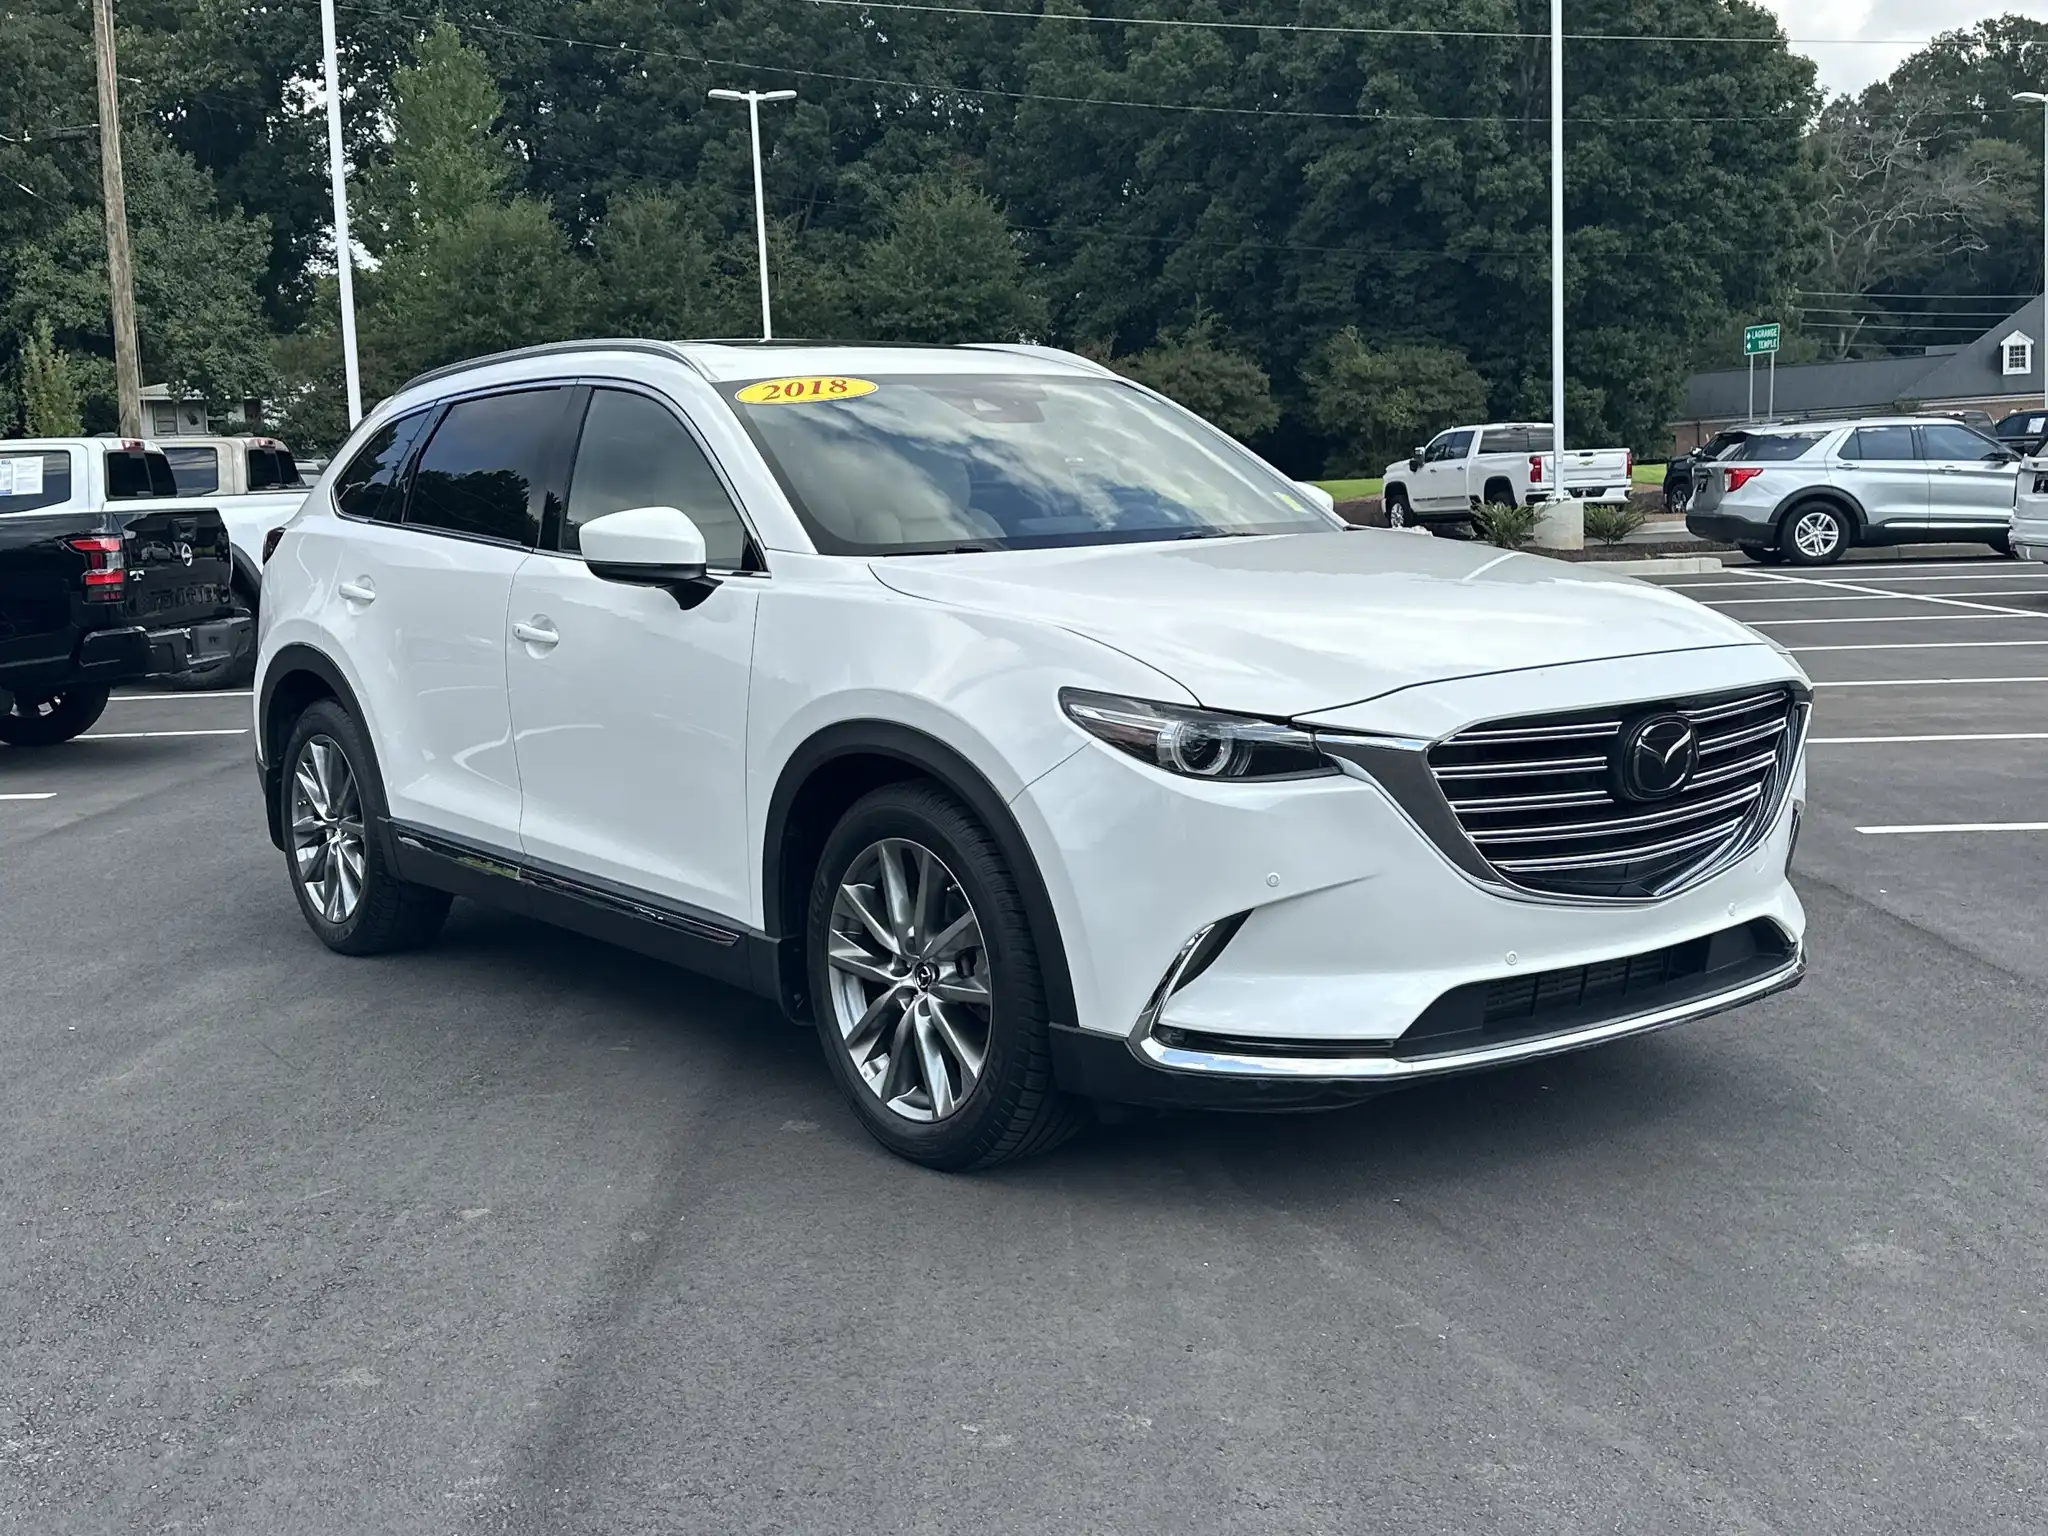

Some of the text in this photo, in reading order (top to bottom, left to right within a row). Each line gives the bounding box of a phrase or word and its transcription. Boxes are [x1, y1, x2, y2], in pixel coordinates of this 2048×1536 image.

[1751, 328, 1778, 340] LAGRANGE
[1758, 339, 1777, 349] TEMPLE
[762, 379, 848, 401] 2018
